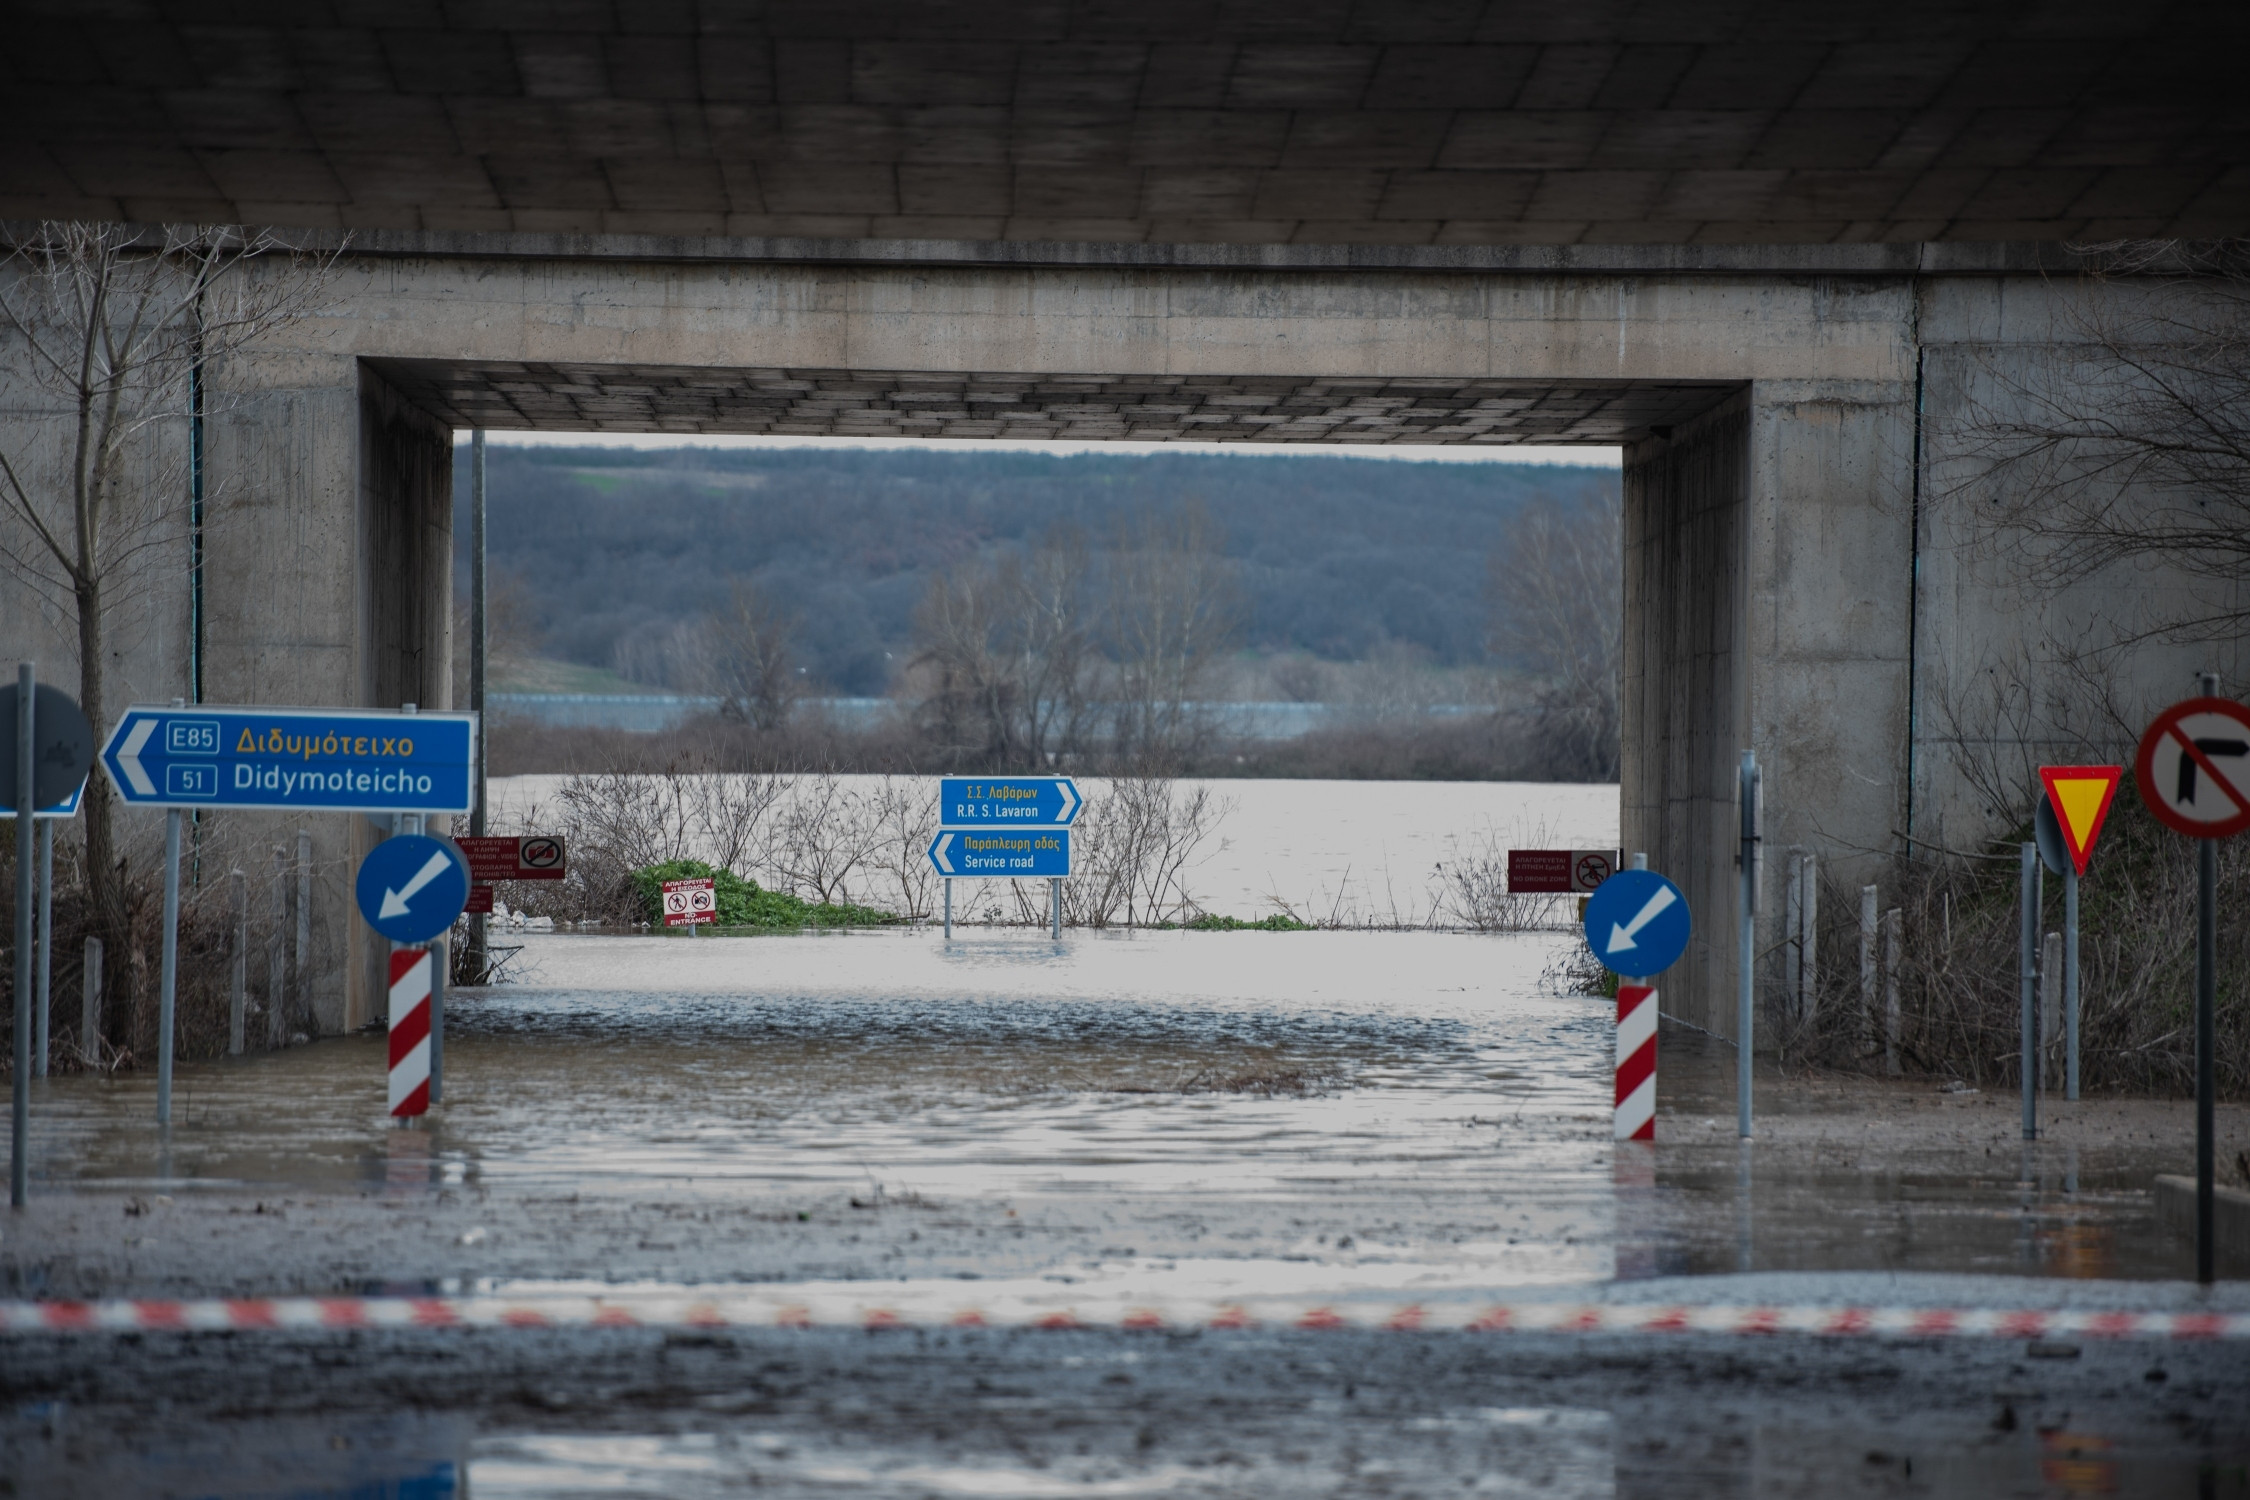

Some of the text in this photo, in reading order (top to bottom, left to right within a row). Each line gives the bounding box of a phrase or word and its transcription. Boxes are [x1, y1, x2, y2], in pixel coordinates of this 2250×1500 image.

[172, 727, 213, 748] E85
[236, 727, 414, 760] Διδυμότειχο
[183, 771, 203, 791] 51
[234, 764, 432, 796] Didymoteicho
[989, 785, 1038, 801] Λαβάρων
[957, 804, 1038, 817] R.R. S. Lavaron
[964, 836, 1060, 852] Παράπλευρη οδός
[965, 855, 1034, 868] Service road
[665, 879, 711, 887] ΑΠΑΓΟΡΕΥΕΤΑΙ
[671, 917, 711, 925] ENTRANCE
